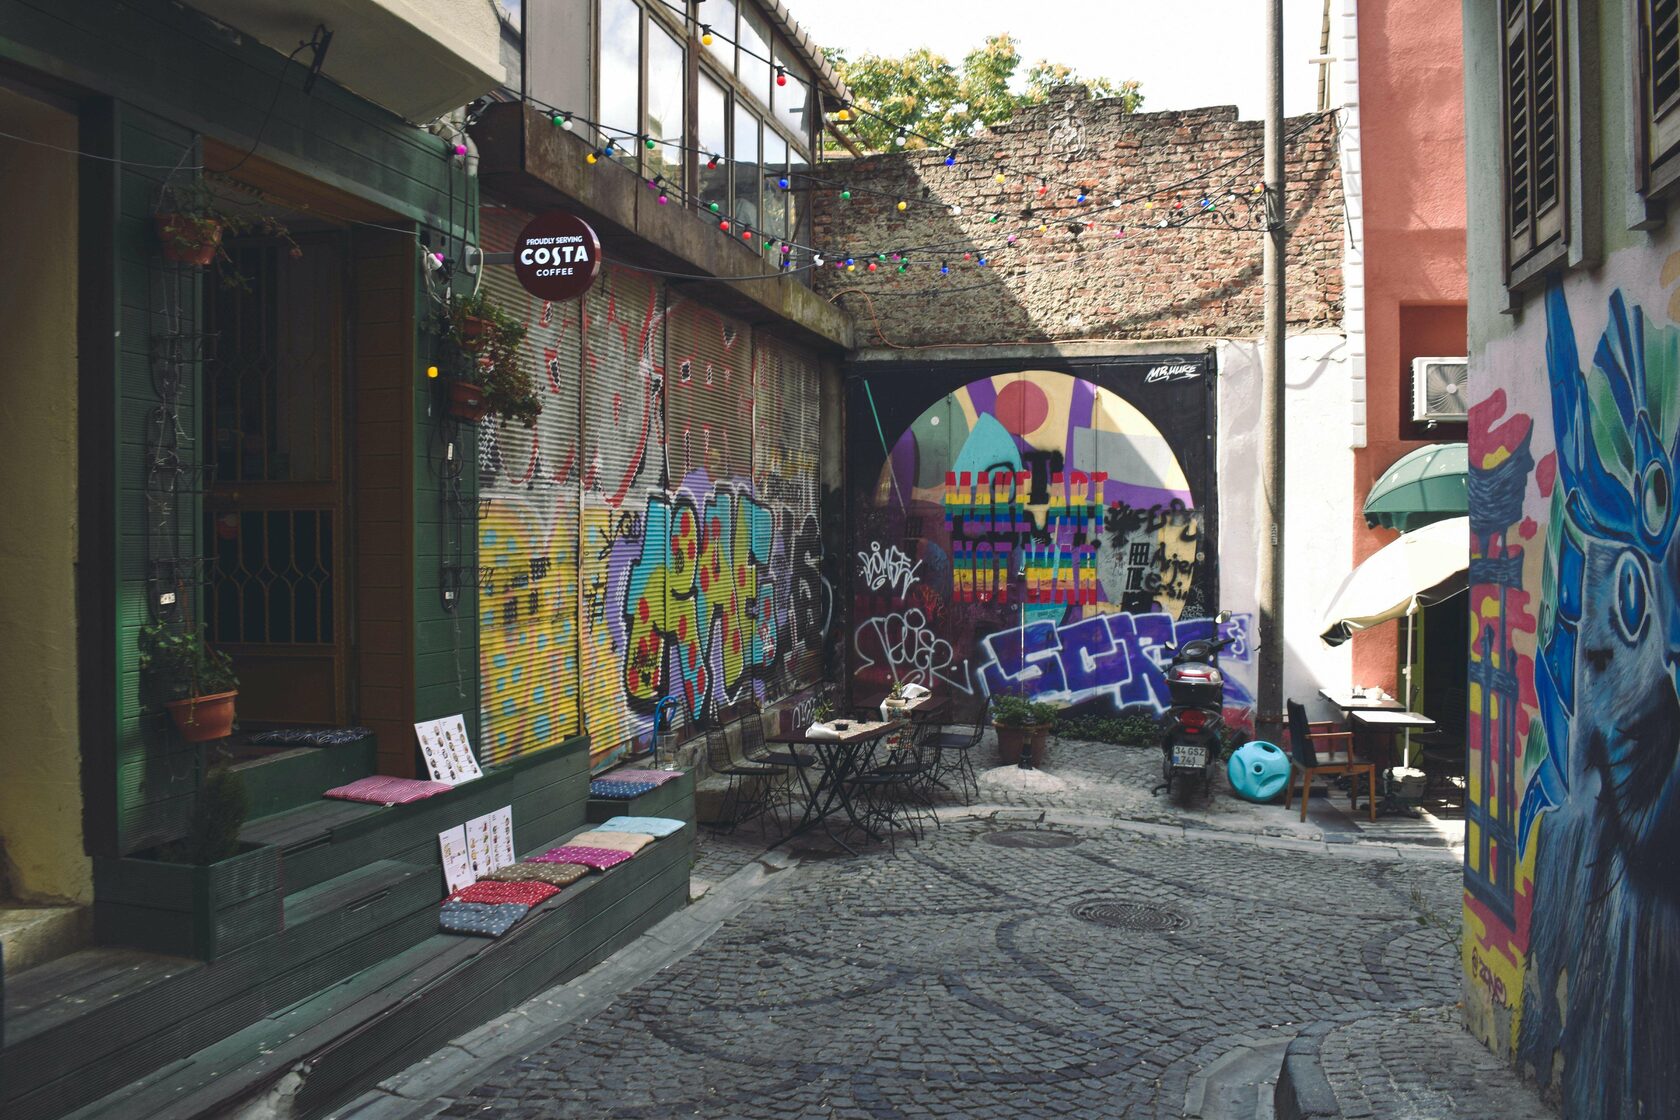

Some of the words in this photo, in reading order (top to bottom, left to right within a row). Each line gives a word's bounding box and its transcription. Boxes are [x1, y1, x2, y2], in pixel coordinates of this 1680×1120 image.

[556, 236, 582, 244] SERVING
[520, 245, 589, 266] COSTA
[536, 268, 573, 276] COFFEE
[944, 471, 1031, 532] MAKE
[1048, 471, 1108, 534] ART
[953, 540, 1012, 603] NOT
[1025, 544, 1096, 605] WAR
[1175, 747, 1186, 755] 34
[1187, 748, 1205, 756] GSZ
